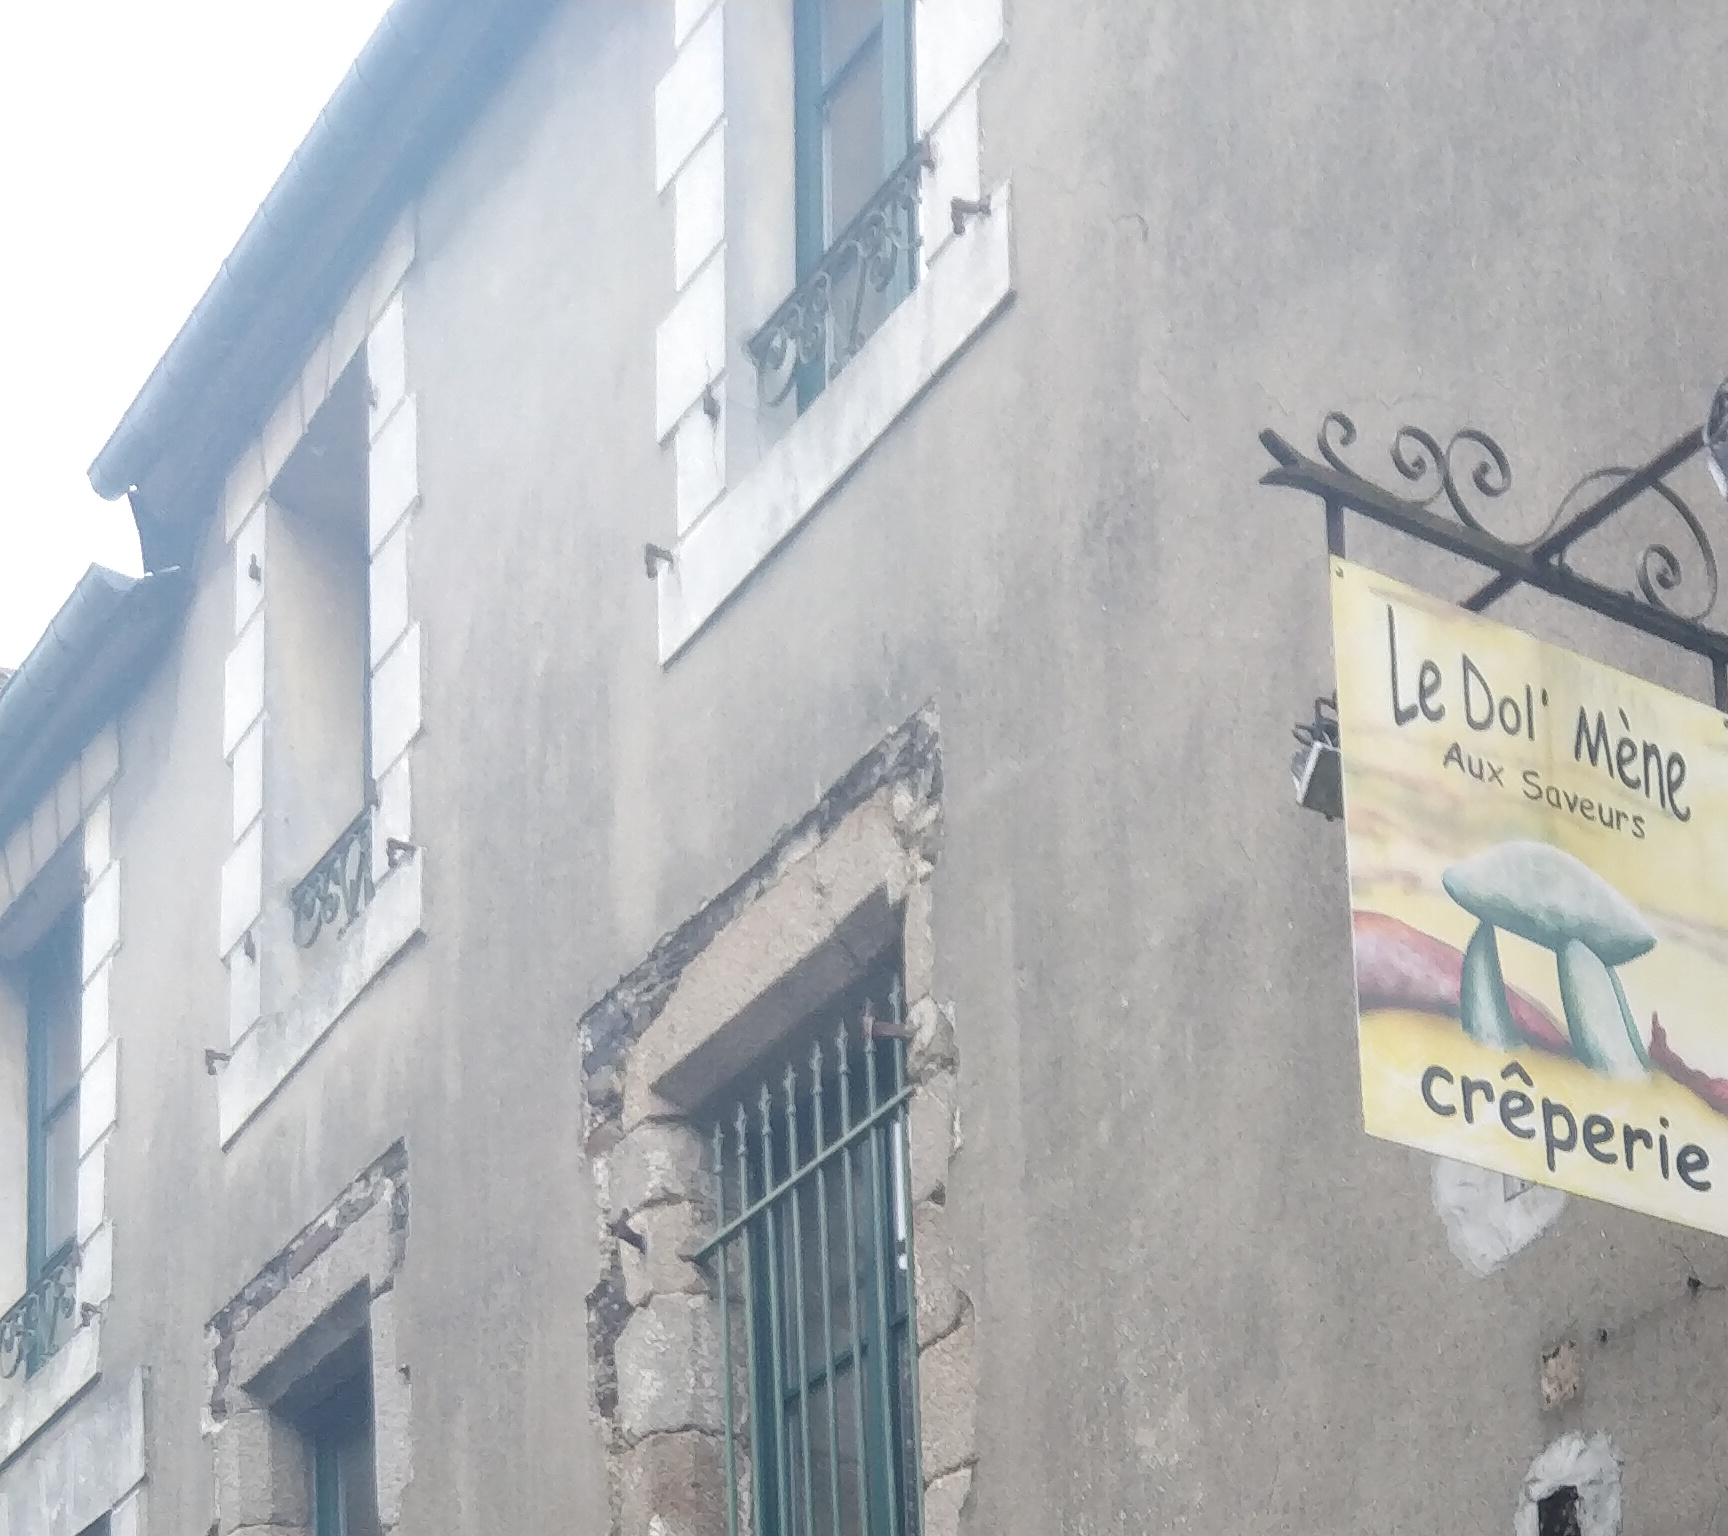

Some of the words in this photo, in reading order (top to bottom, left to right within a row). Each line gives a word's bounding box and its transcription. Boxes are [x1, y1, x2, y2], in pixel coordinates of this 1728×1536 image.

[1387, 604, 1446, 727] Le
[1462, 653, 1549, 741] Dol'
[1574, 705, 1692, 822] Mène
[1443, 742, 1504, 788] Aux
[1522, 770, 1646, 839] Saveurs
[1420, 1061, 1712, 1191] crêperie
